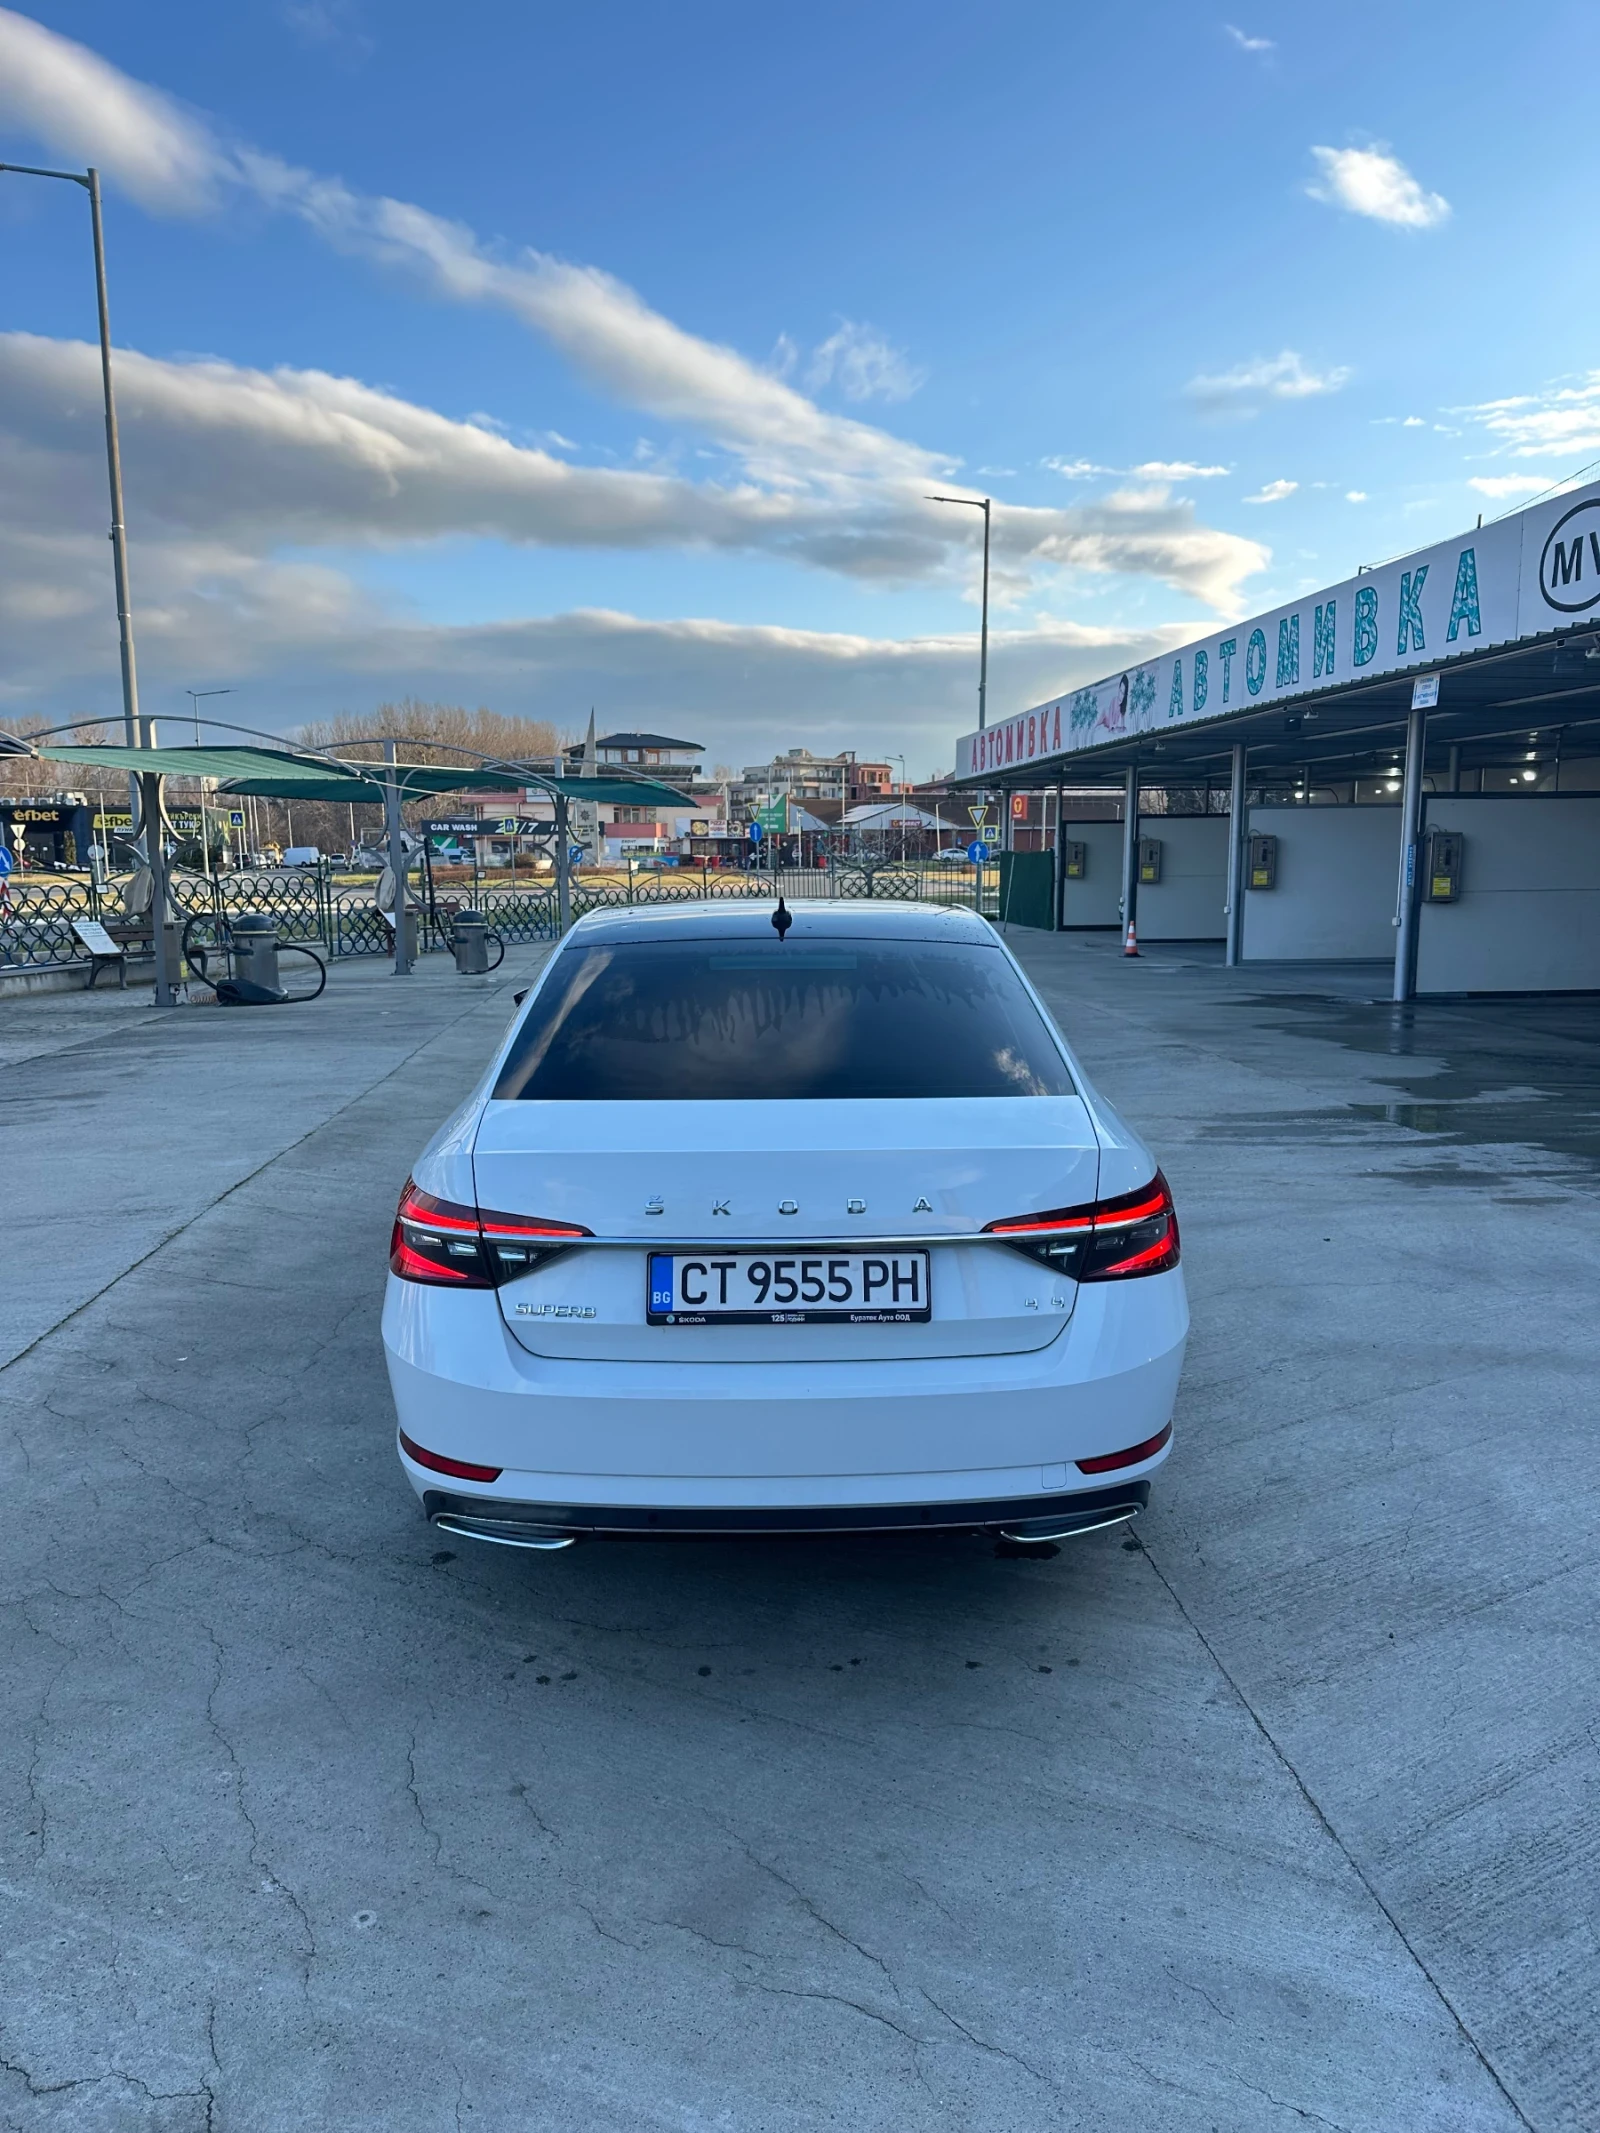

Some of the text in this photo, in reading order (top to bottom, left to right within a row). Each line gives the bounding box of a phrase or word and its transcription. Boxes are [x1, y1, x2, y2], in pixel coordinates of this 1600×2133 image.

[1168, 547, 1482, 718] АВТОМИВКА
[971, 706, 1061, 773] АВТОМИВКА
[13, 809, 59, 821] efbet
[100, 816, 132, 827] efbe
[430, 822, 539, 834] CAR WASH 2/7
[645, 1194, 933, 1216] ŠKODA
[681, 1260, 919, 1305] CT 9555 PH
[653, 1291, 671, 1305] BG
[515, 1302, 597, 1319] SUPERB
[678, 1315, 706, 1323] ŠKODA
[771, 1314, 785, 1323] 125
[878, 1314, 894, 1323] Ауто
[895, 1313, 911, 1322] ООД
